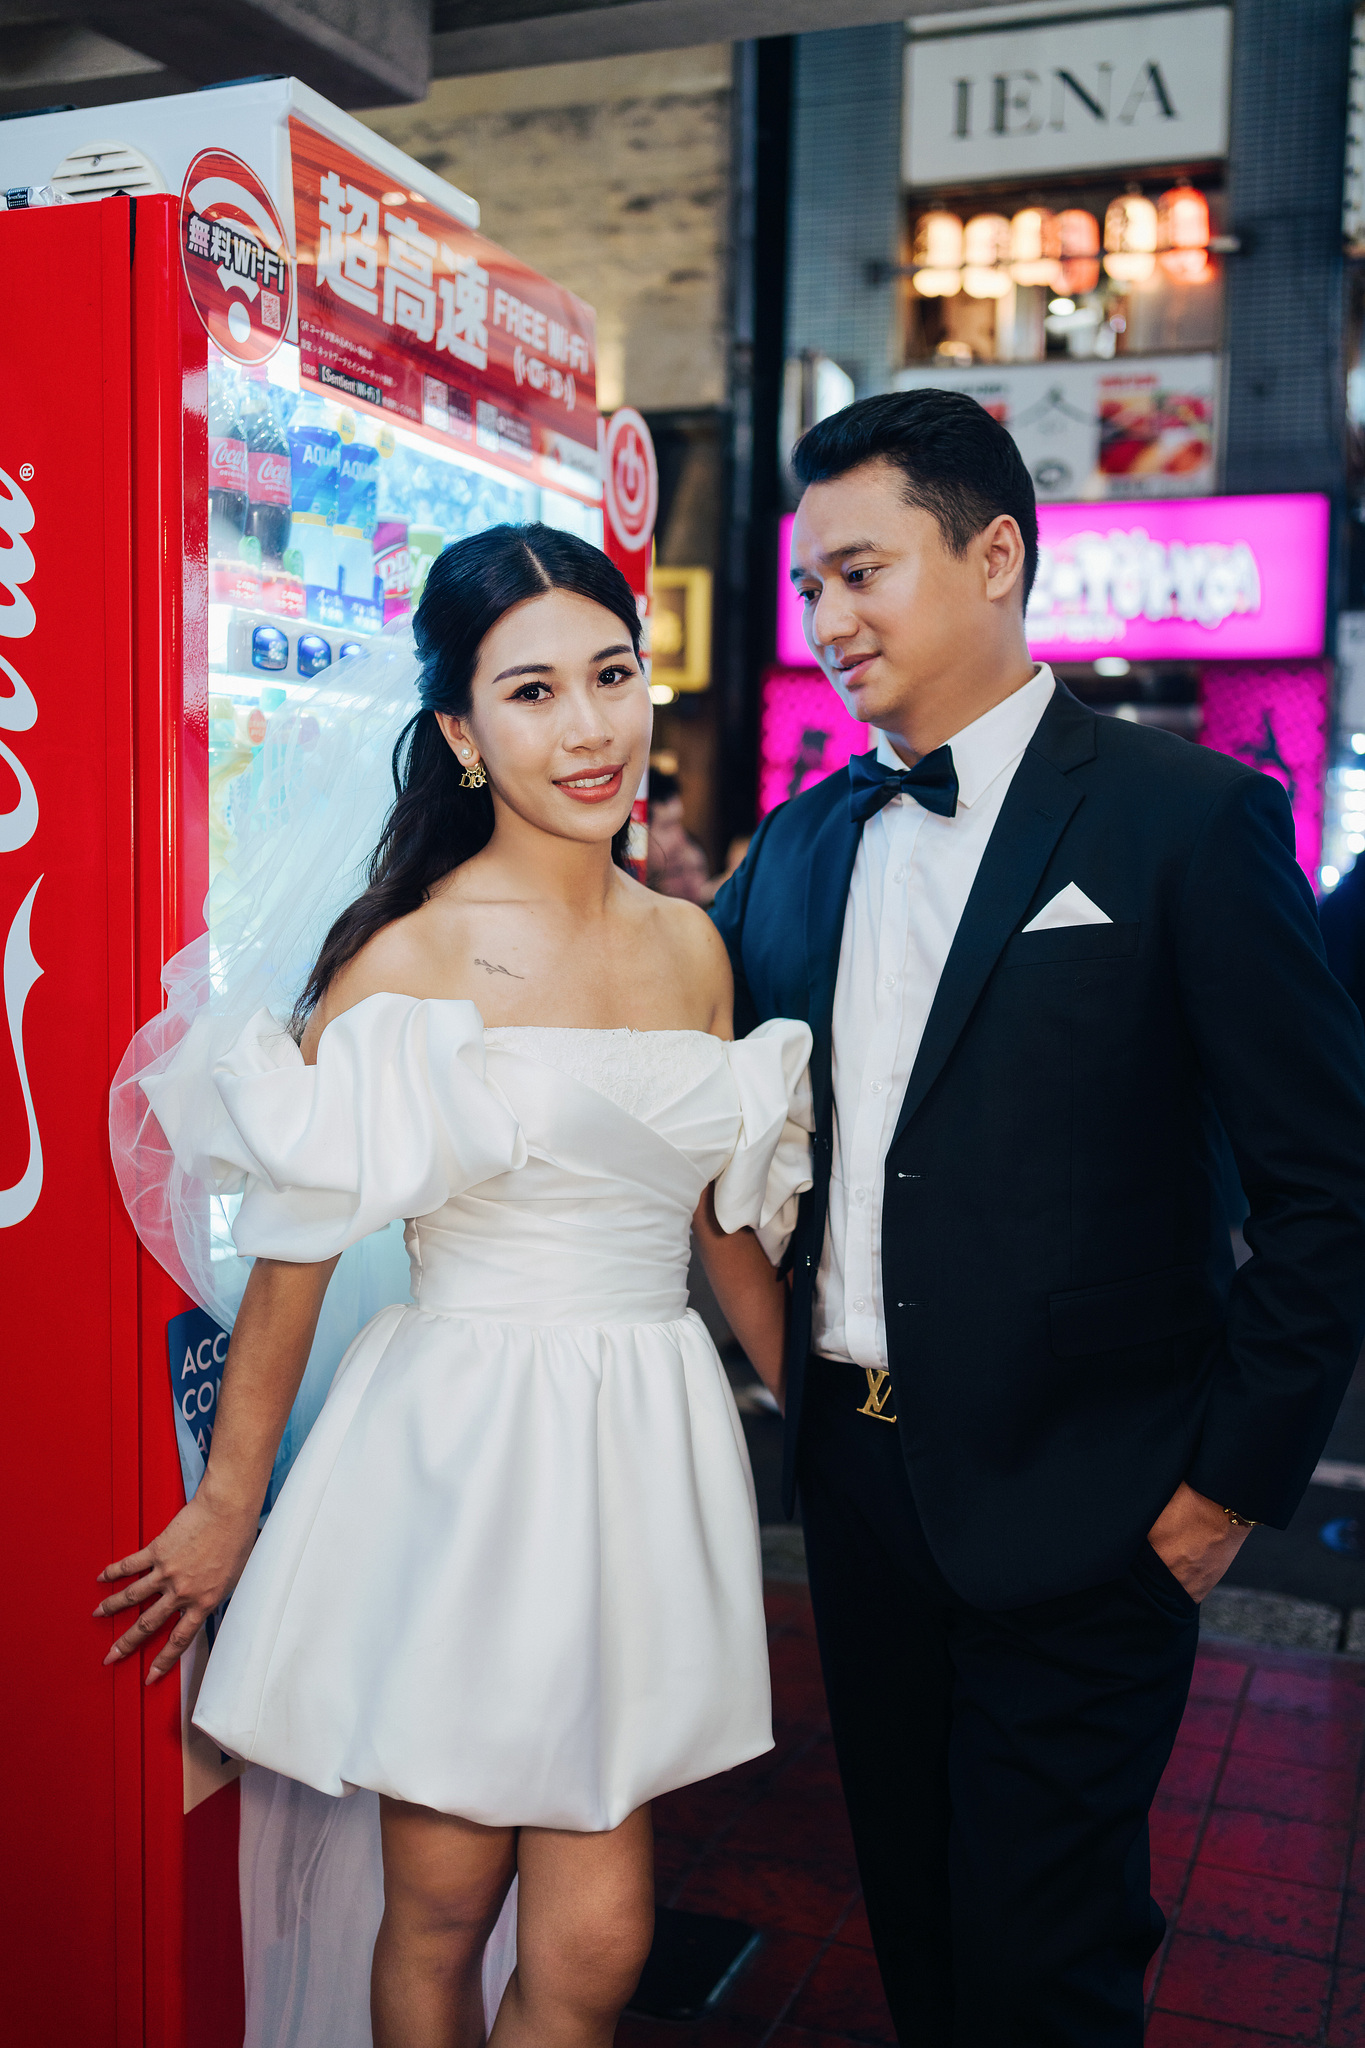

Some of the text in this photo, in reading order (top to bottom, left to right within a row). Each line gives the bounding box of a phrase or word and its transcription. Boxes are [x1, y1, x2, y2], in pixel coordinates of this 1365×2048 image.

[952, 58, 1178, 141] IENA
[188, 215, 285, 292] 無料Wi-Fi
[316, 170, 490, 371] 超高速
[493, 288, 547, 351] FREE
[181, 1332, 228, 1380] ACC
[182, 1377, 221, 1421] CO
